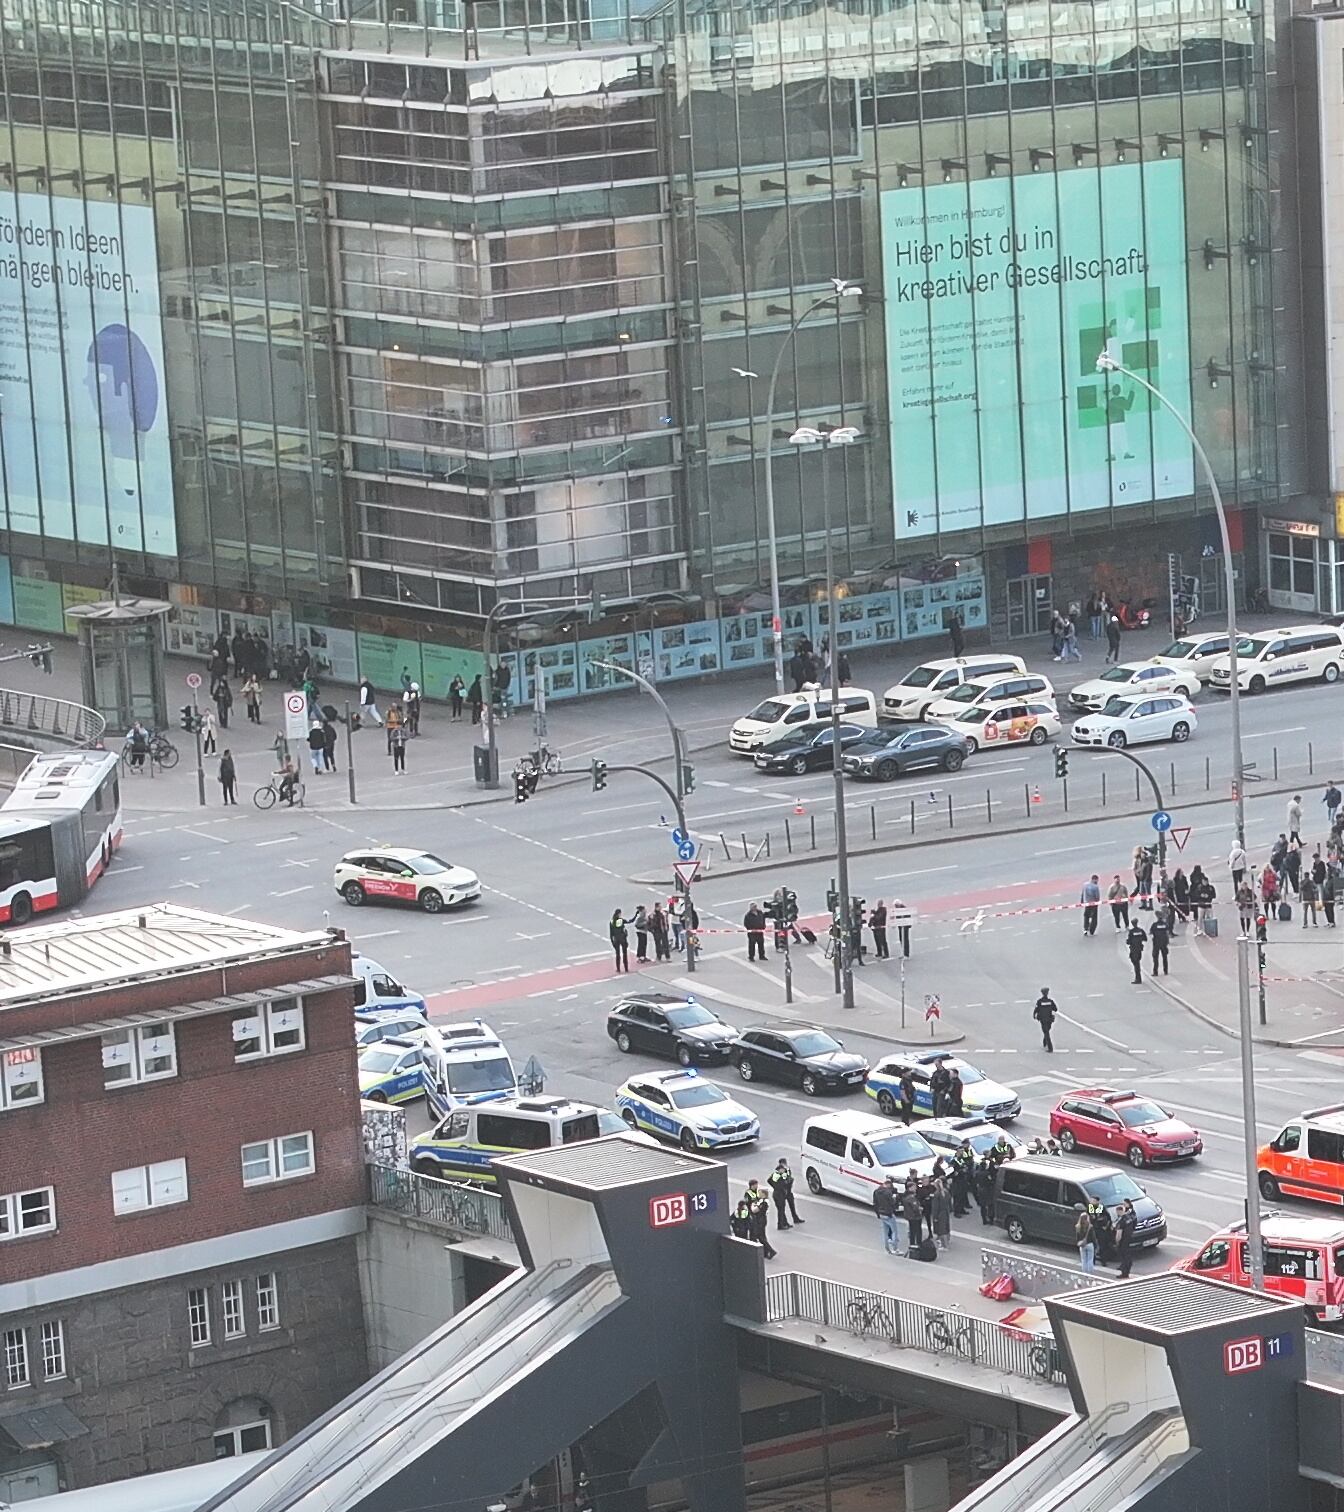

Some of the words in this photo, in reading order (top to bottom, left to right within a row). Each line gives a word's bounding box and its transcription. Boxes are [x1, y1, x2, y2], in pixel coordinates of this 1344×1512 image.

[70, 225, 120, 256] Ideen
[896, 239, 944, 267] Hier
[951, 232, 992, 260] bist
[1000, 226, 1026, 254] du
[1035, 225, 1053, 250] in
[68, 260, 138, 294] bleiben.
[898, 271, 998, 304] kreativer
[655, 1199, 685, 1223] DB
[691, 1193, 708, 1212] 13
[1281, 1262, 1296, 1276] 112
[1231, 1341, 1259, 1370] DB
[1267, 1338, 1281, 1356] 11
